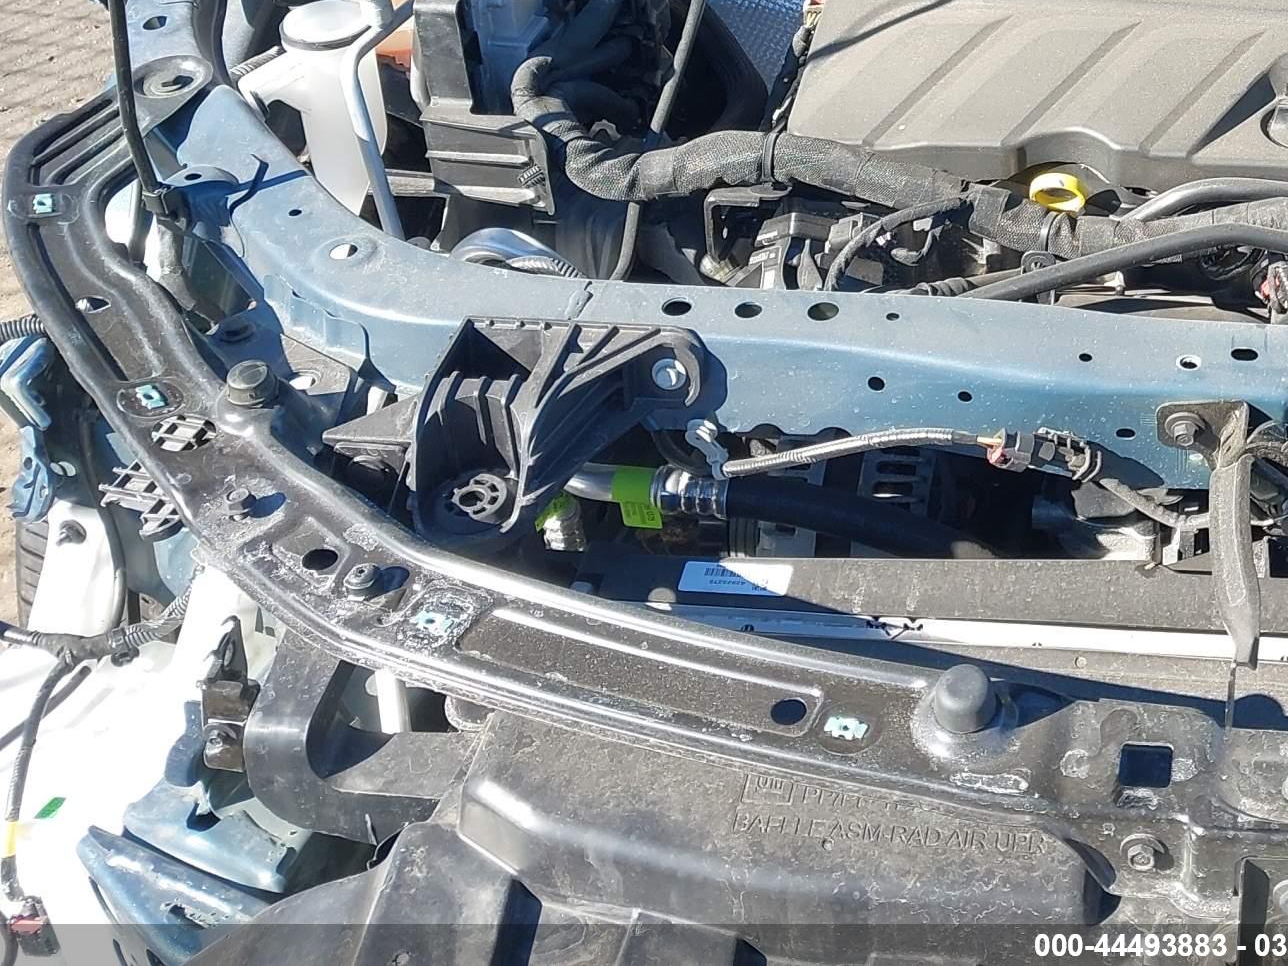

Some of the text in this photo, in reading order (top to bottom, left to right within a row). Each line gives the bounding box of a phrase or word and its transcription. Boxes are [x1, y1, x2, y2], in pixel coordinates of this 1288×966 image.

[732, 812, 829, 838] BAFFLE
[945, 828, 989, 851] AIR
[994, 830, 1048, 854] UPR
